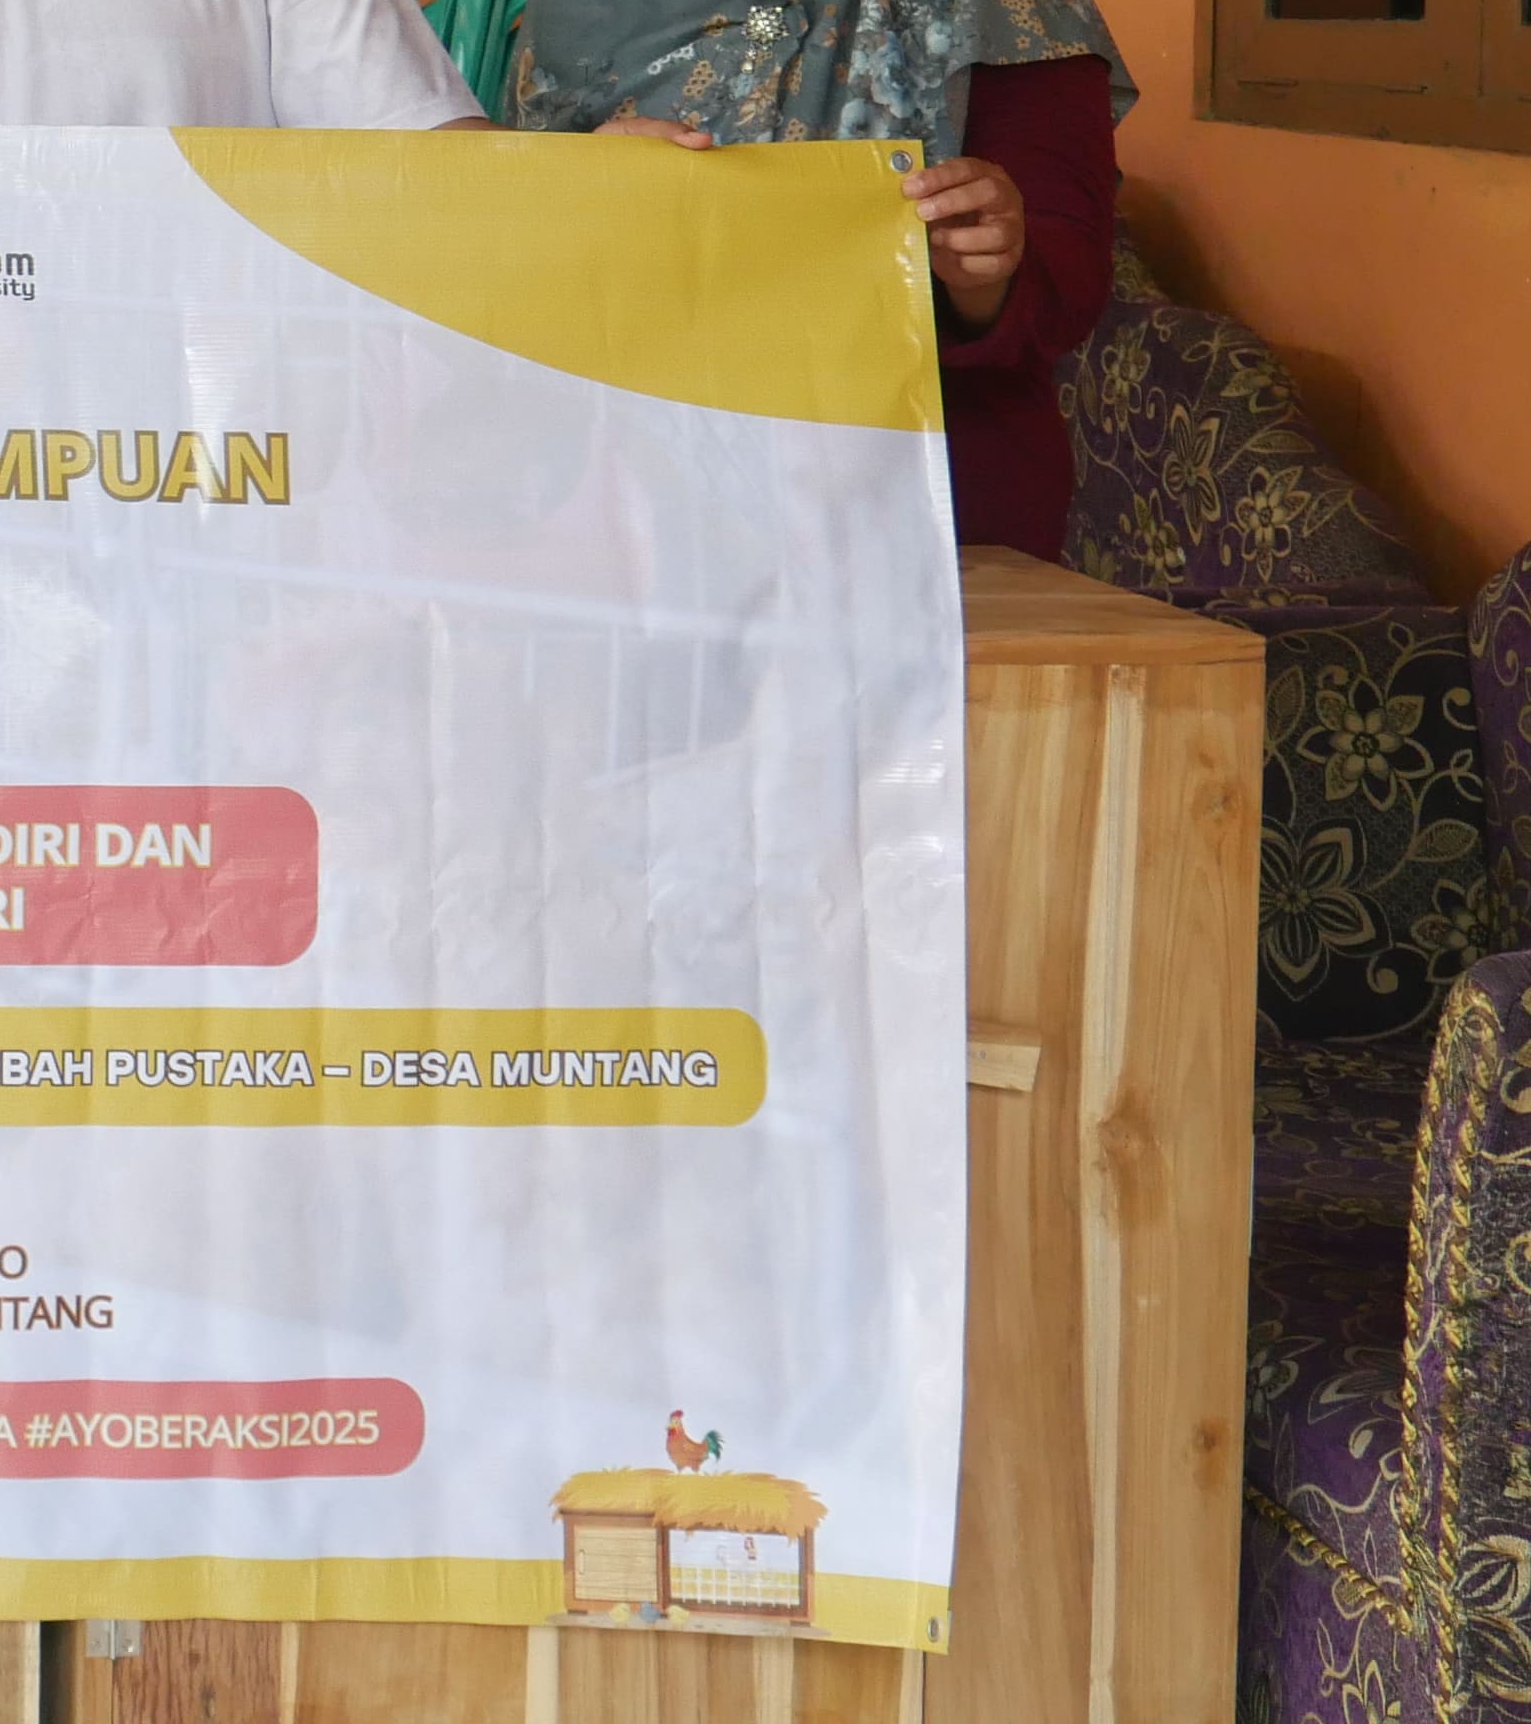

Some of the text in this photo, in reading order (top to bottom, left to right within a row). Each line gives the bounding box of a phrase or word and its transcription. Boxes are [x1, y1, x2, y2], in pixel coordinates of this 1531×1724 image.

[94, 822, 213, 868] DAN
[105, 1049, 316, 1087] PUSTAKA
[360, 1050, 482, 1088] DESA
[490, 1049, 719, 1089] MUNTANG
[24, 1409, 381, 1449] #AYOBERAKSI2025
